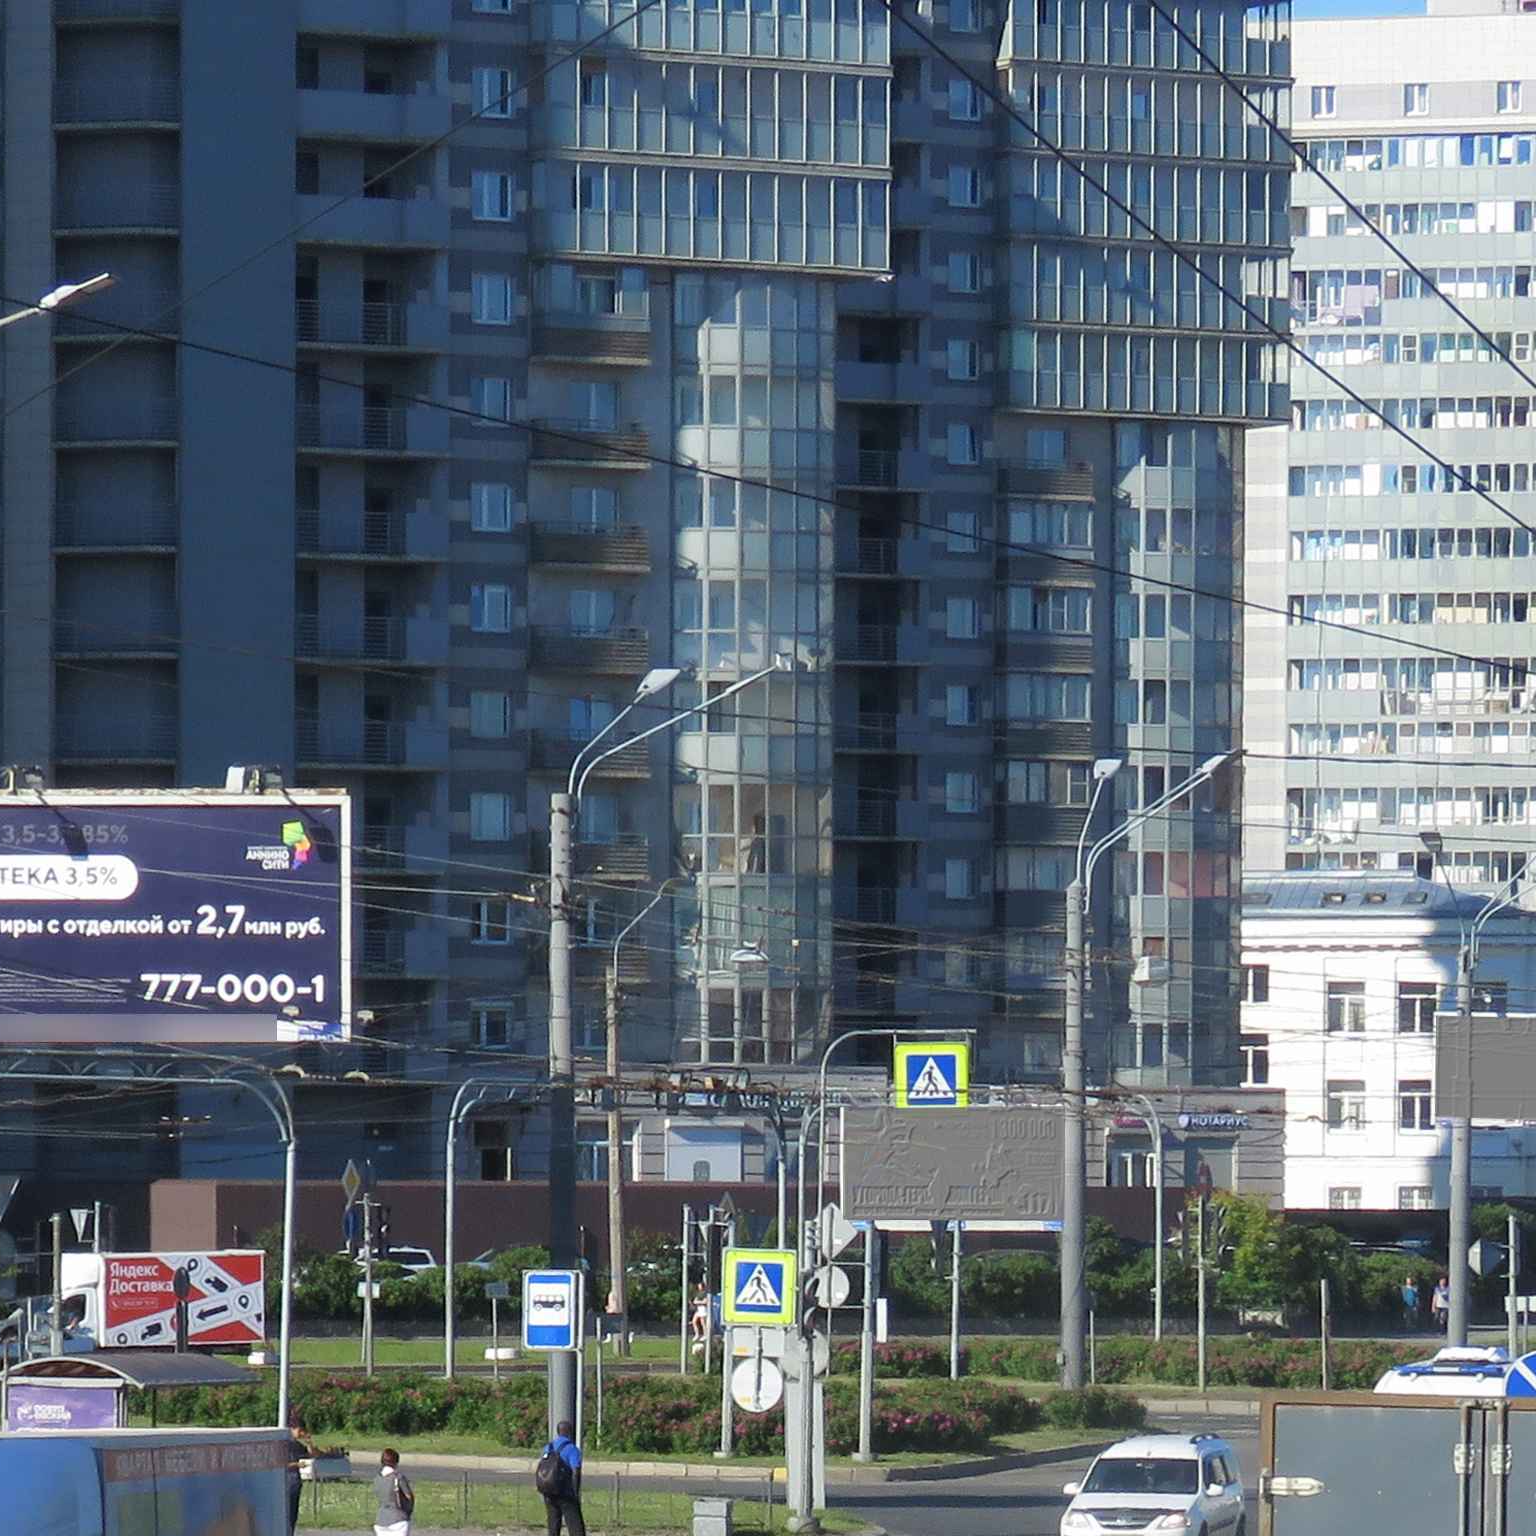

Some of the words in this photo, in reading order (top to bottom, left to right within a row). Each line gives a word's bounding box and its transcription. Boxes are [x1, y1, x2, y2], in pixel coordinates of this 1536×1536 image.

[246, 850, 289, 860] АННИНО
[262, 860, 290, 870] СИТИ
[65, 867, 118, 887] 3,5%
[48, 919, 59, 934] с
[64, 915, 163, 937] отделкой
[168, 919, 193, 934] от
[196, 905, 246, 938] 2,7
[245, 921, 281, 935] млн
[285, 917, 326, 938] руб.
[140, 973, 325, 1003] 777-000-1
[1191, 1115, 1249, 1126] НОТАРИУС
[110, 1262, 159, 1278] Яндекс
[110, 1279, 174, 1295] Доставка
